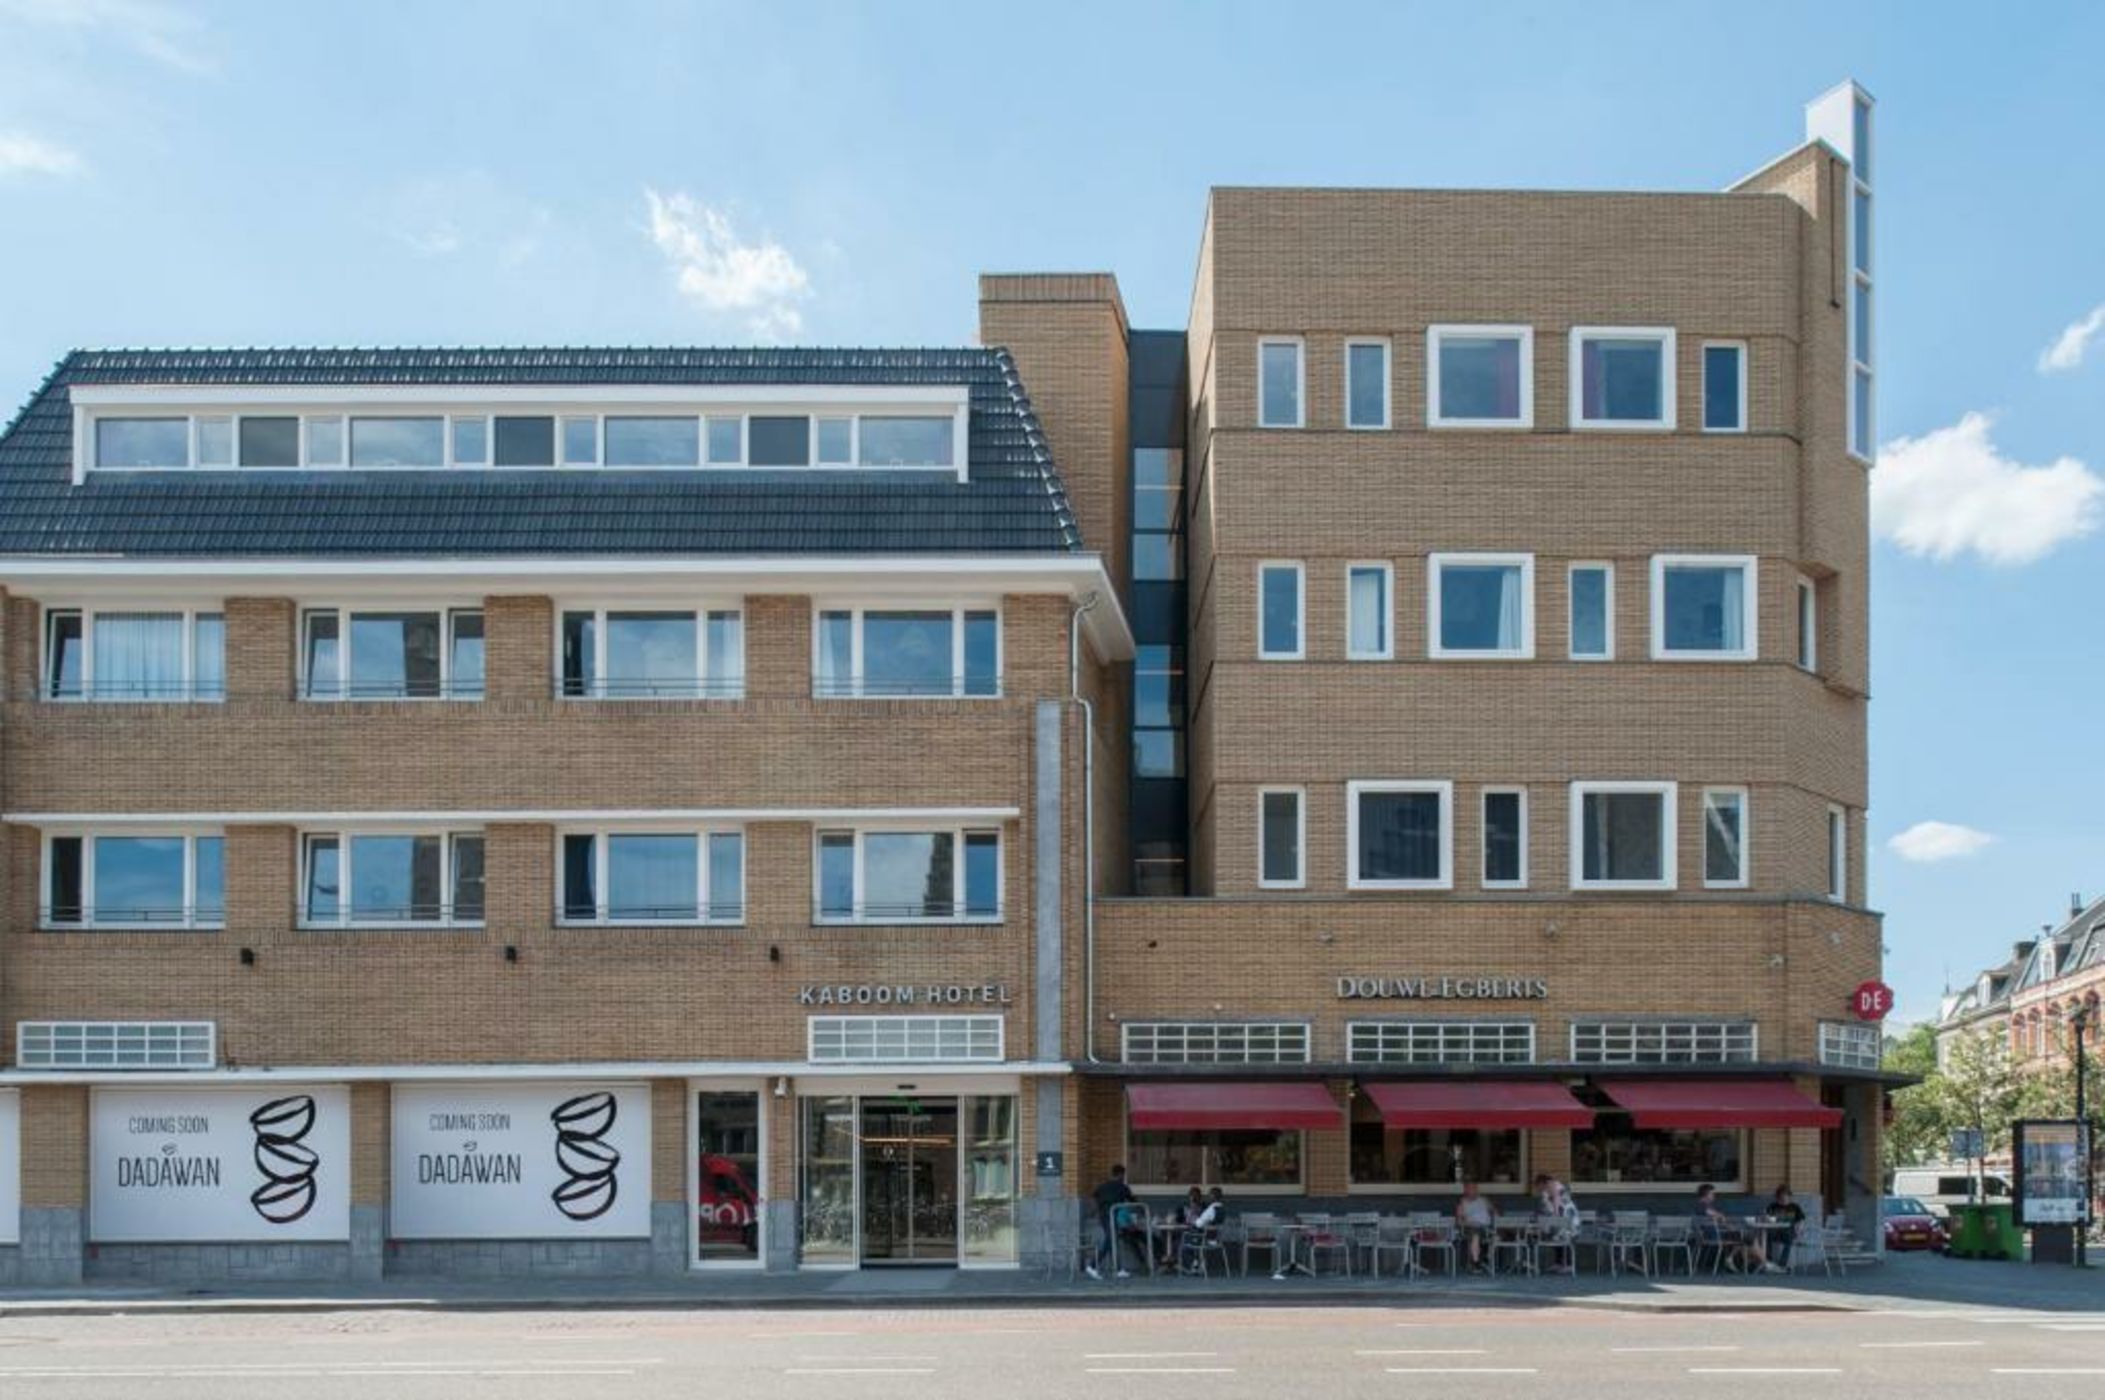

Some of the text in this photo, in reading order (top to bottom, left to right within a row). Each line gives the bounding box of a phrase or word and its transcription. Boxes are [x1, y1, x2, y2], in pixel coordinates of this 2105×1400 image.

[800, 984, 1012, 1004] KABOOM HOTEL
[1441, 976, 1548, 999] EGBERTS
[128, 1116, 209, 1134] COMING SOON
[428, 1113, 511, 1131] COMING SOON
[118, 1157, 220, 1187] DADAWAN
[418, 1154, 521, 1184] DADAWAN
